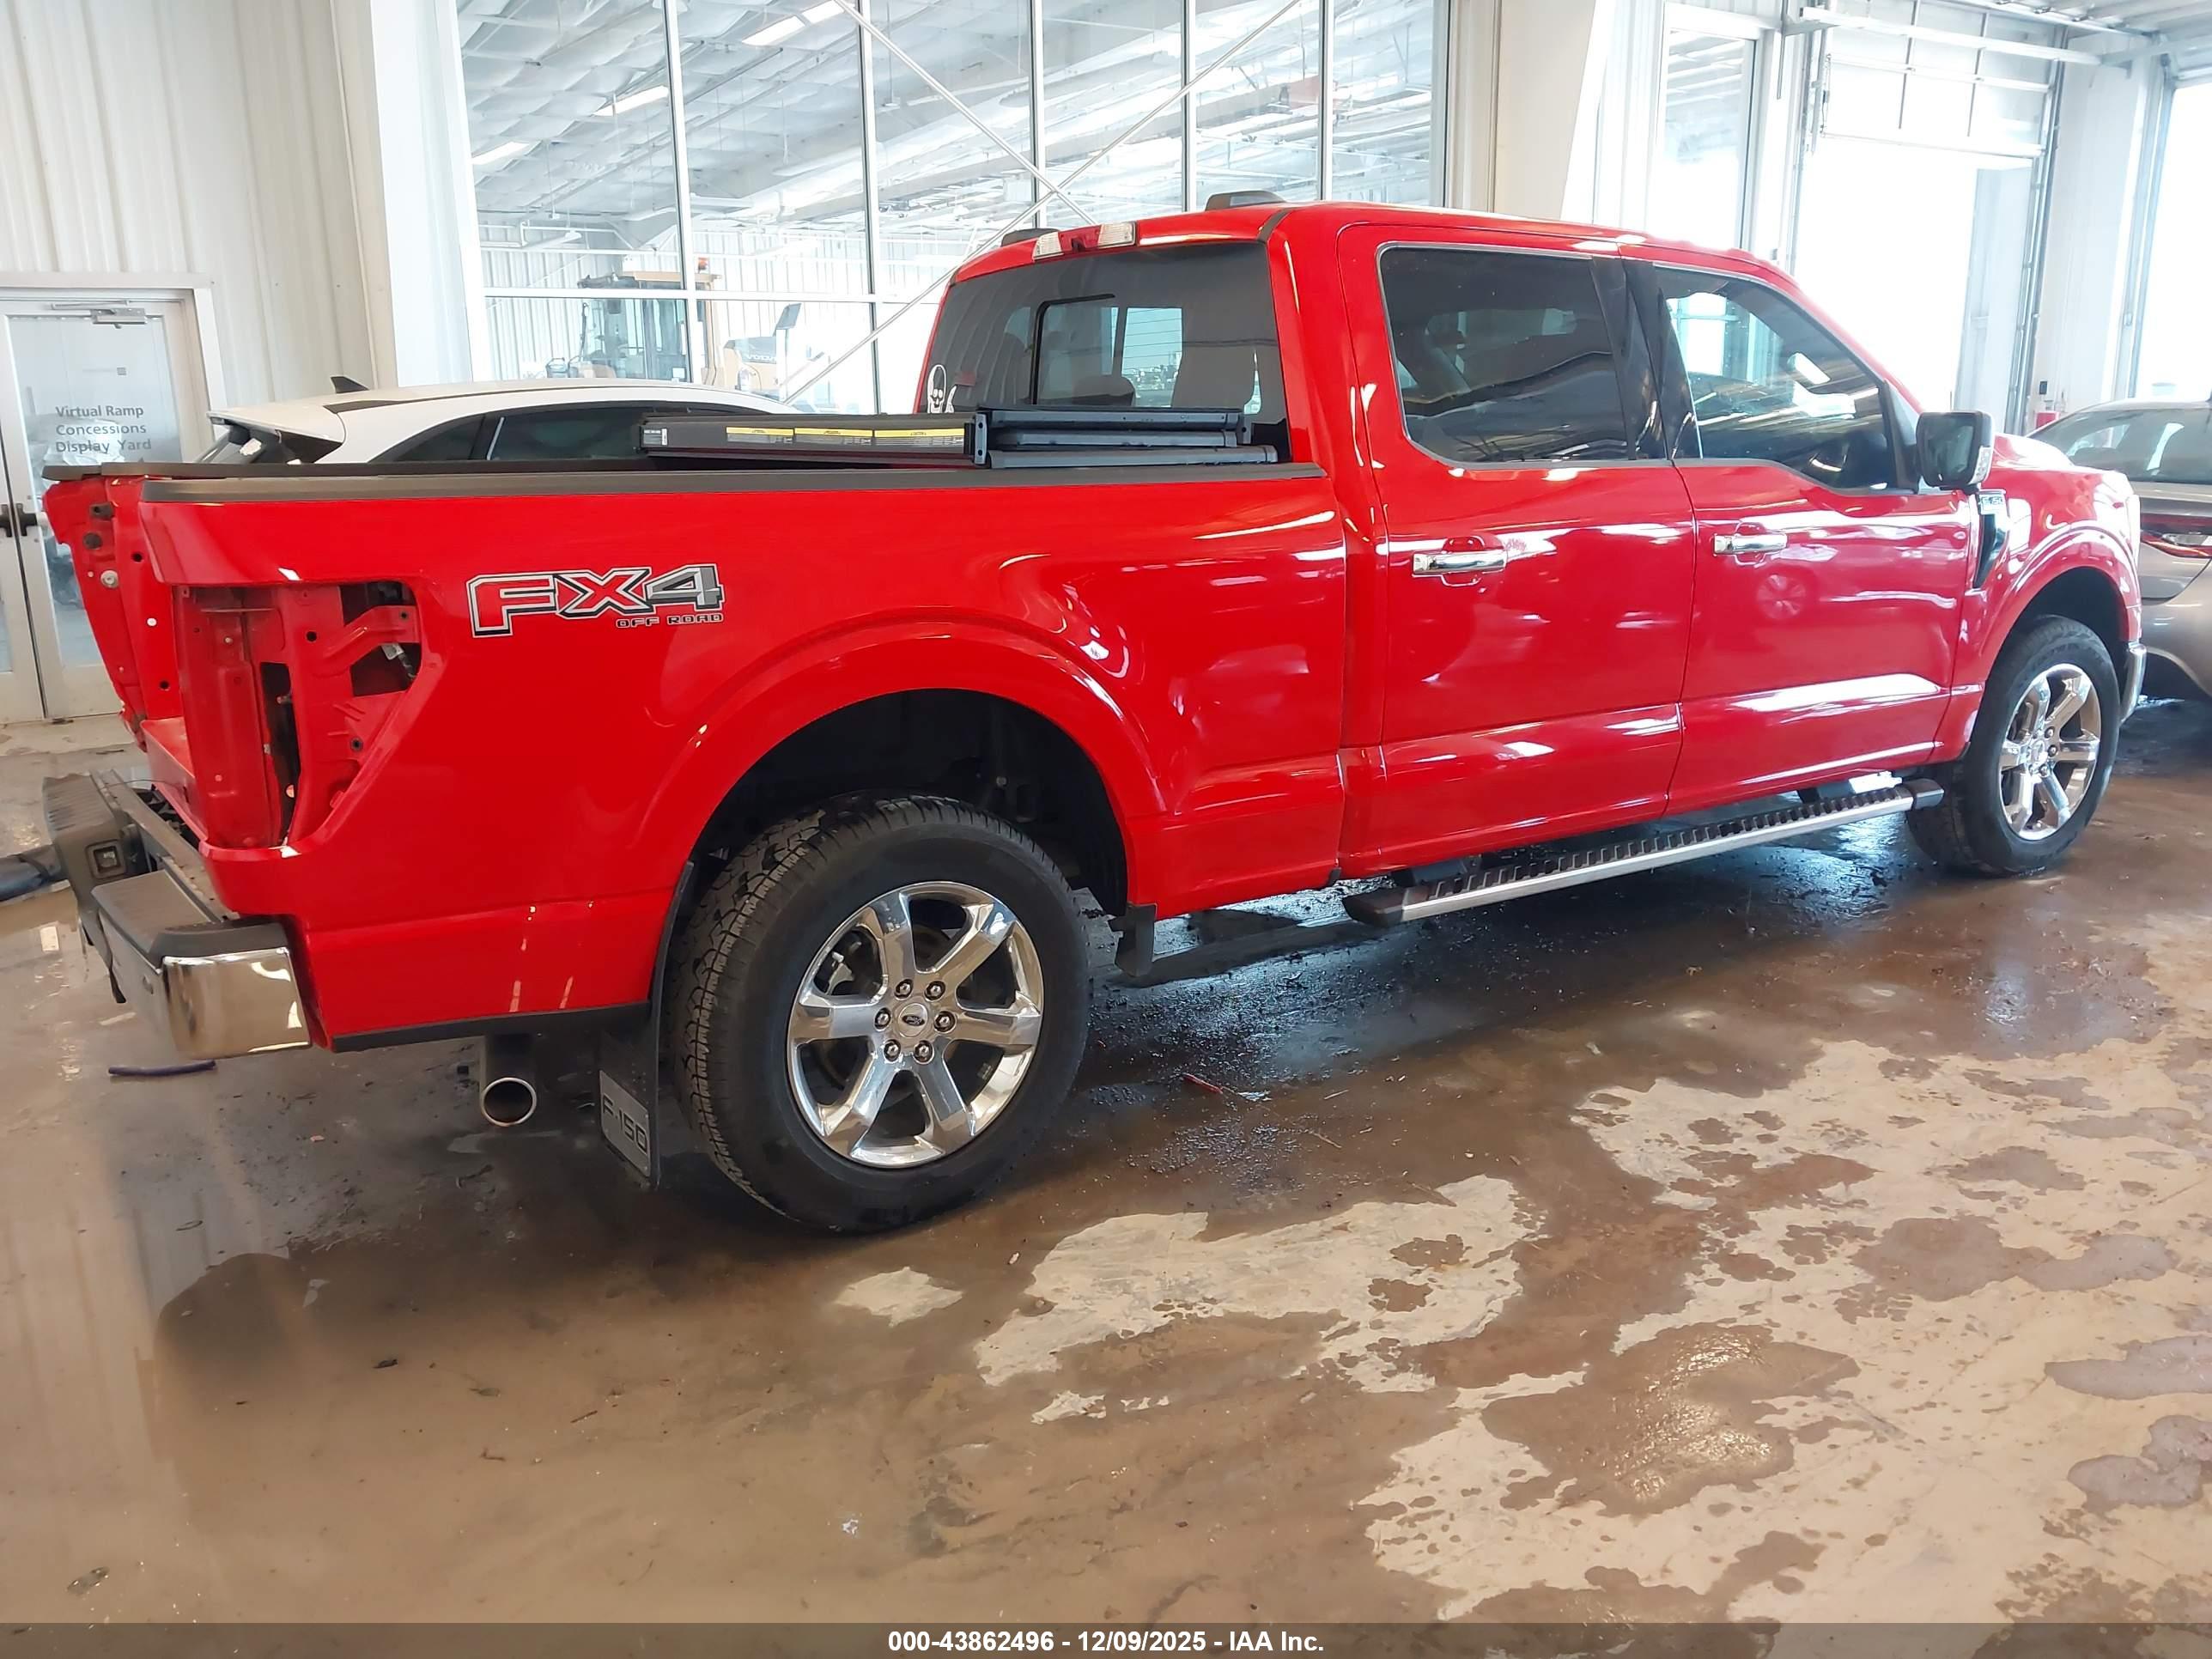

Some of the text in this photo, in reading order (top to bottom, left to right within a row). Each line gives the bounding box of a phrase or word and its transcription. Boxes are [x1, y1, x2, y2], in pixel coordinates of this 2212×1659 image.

[55, 405, 144, 418] Virtual Ramp
[56, 424, 147, 435] Concessions
[56, 439, 152, 454] Display Yard
[466, 563, 725, 638] FX4
[615, 613, 724, 629] OFF ROAD
